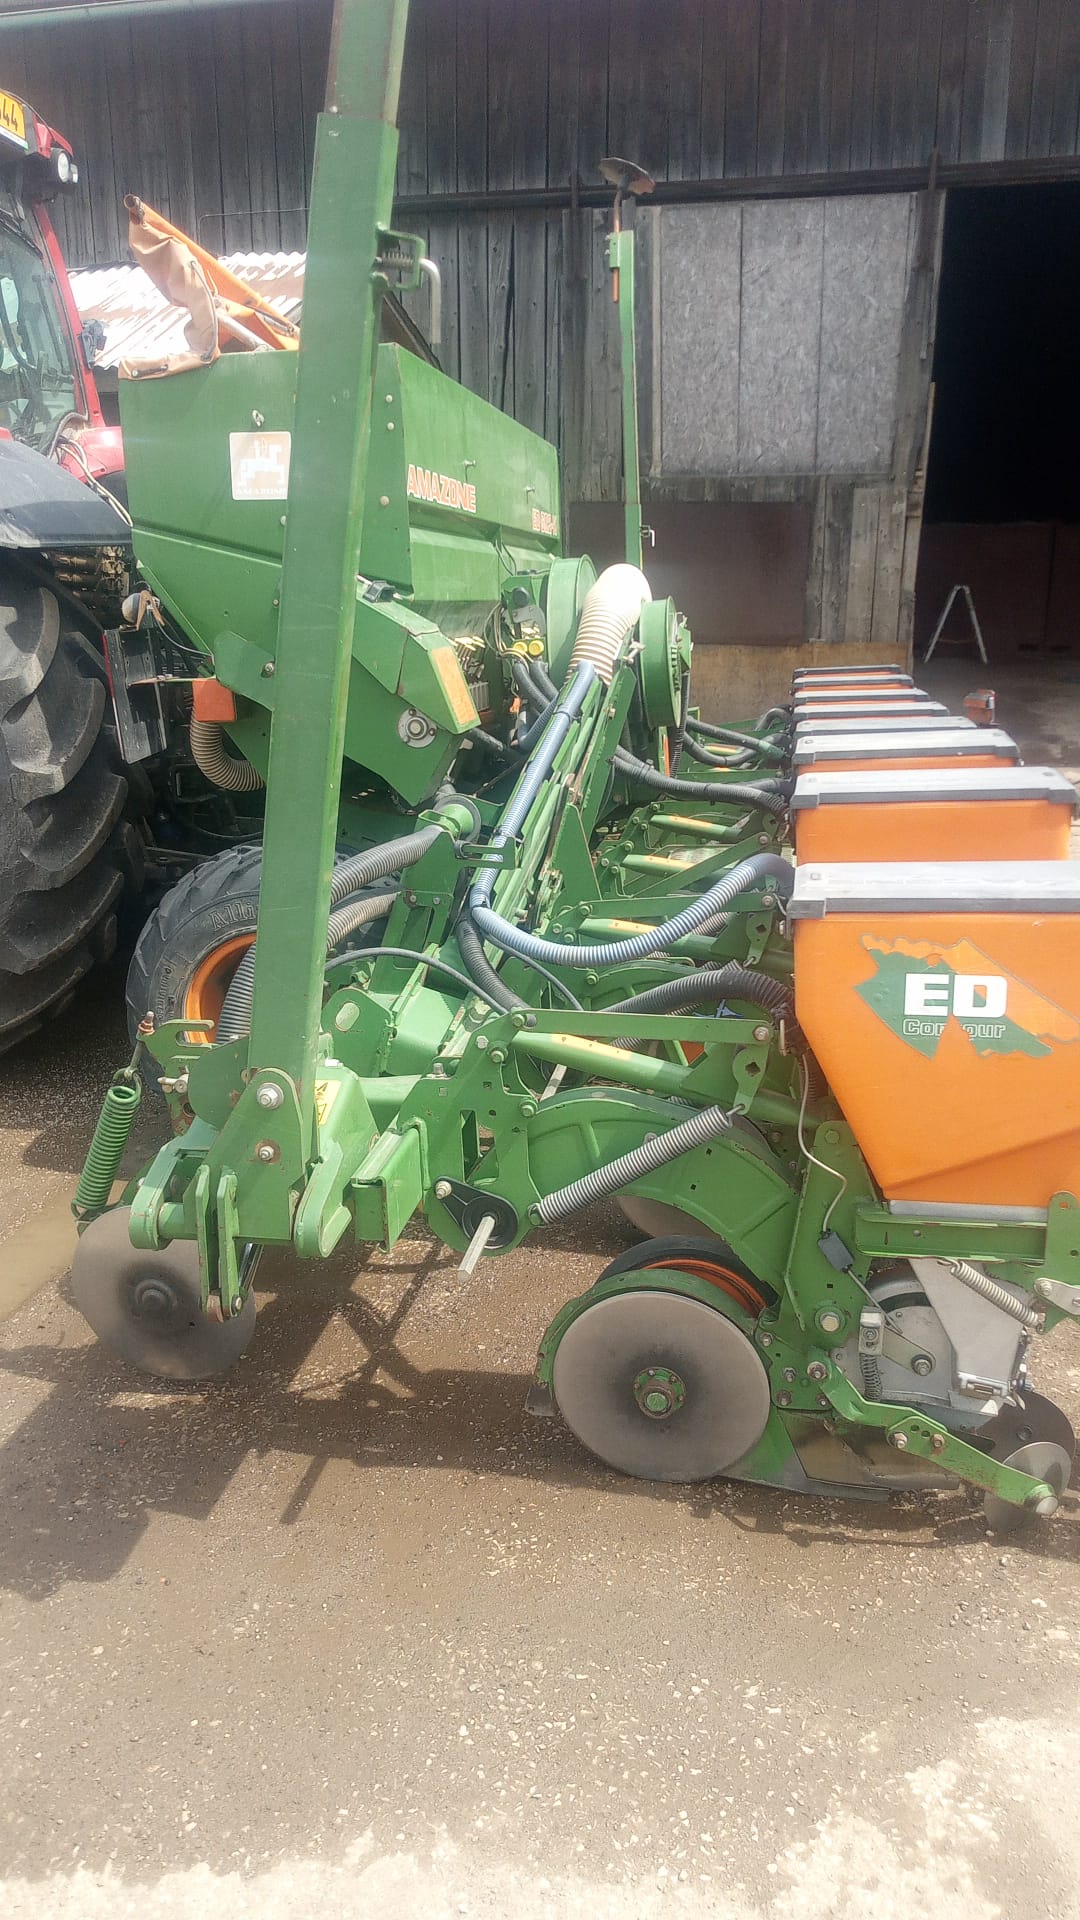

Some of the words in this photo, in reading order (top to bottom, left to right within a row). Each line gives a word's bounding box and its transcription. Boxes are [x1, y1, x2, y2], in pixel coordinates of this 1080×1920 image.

[0, 98, 17, 131] 44
[407, 464, 476, 513] AMAZONE
[208, 900, 258, 932] Alli
[903, 972, 1008, 1018] ED
[903, 1018, 1006, 1039] Conour
